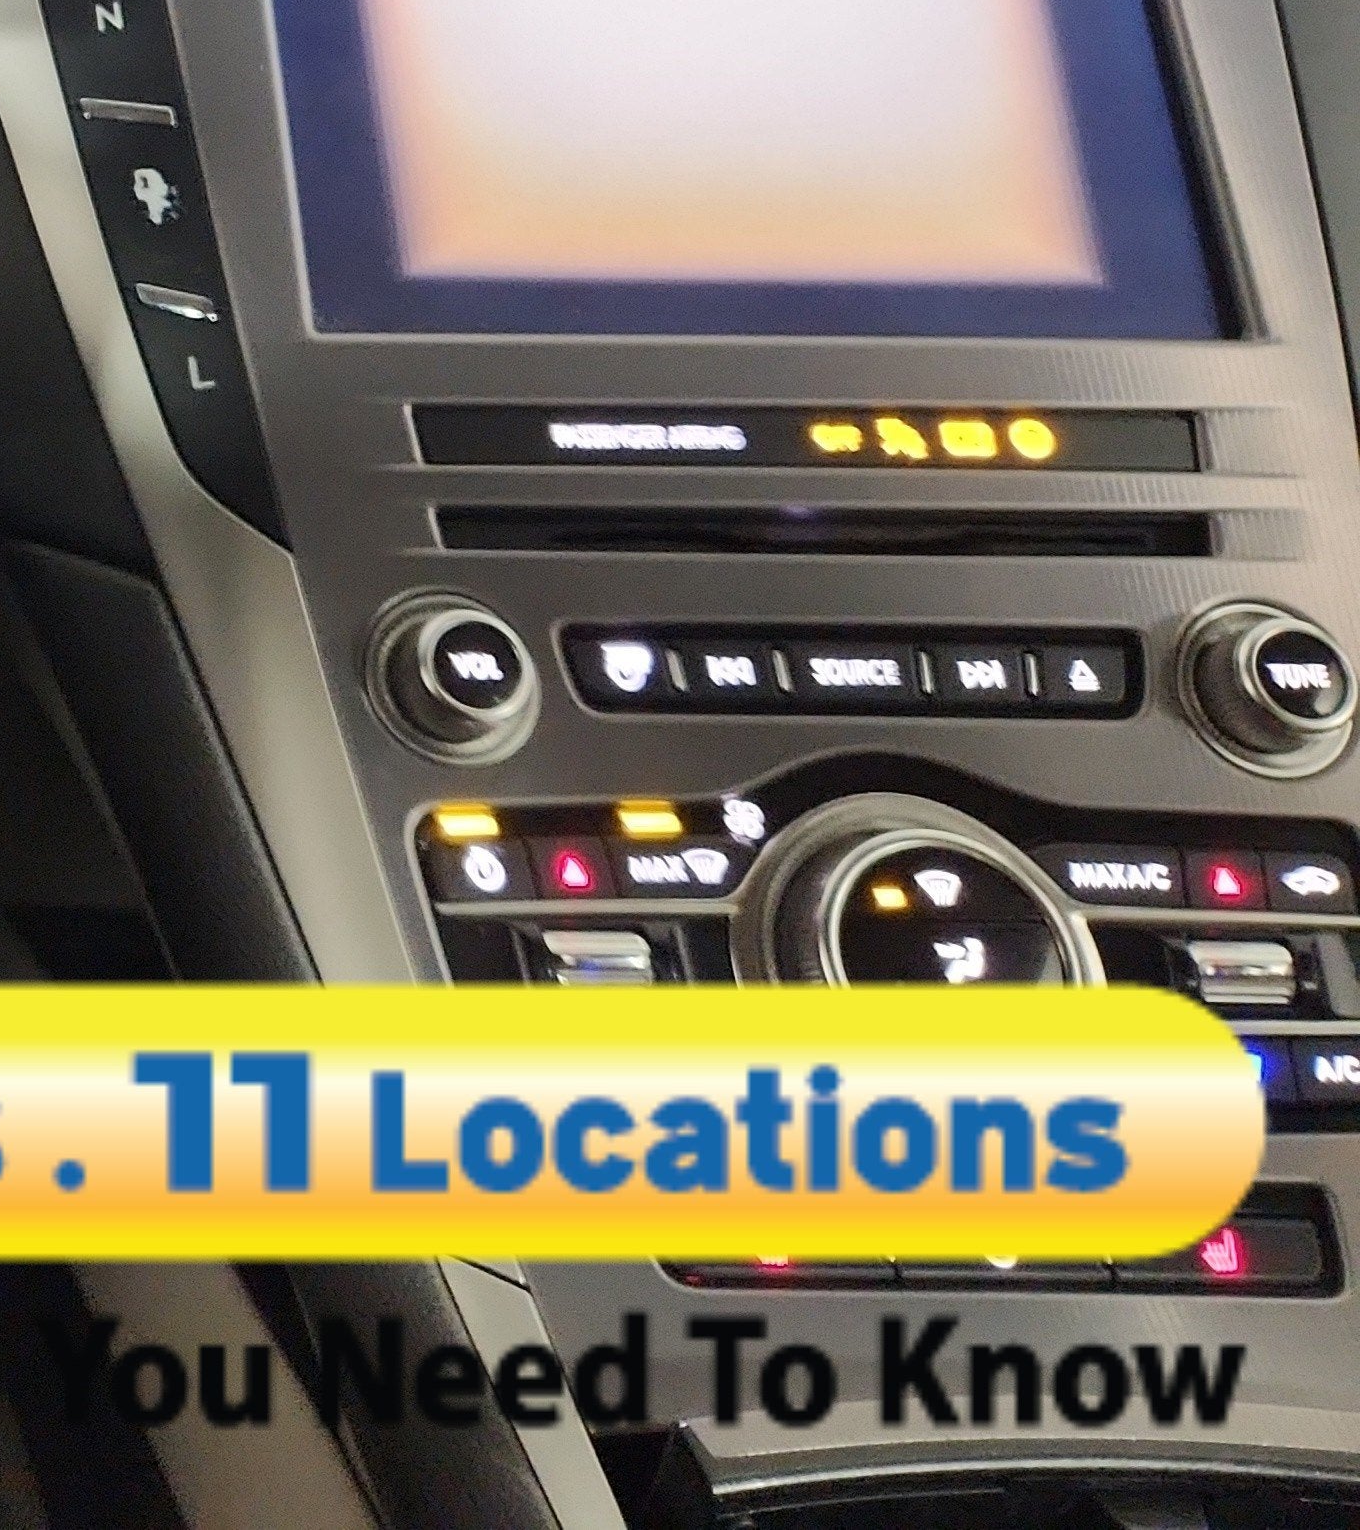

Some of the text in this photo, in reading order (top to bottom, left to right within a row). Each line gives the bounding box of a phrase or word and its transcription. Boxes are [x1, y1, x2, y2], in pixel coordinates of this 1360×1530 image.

[95, 0, 125, 33] N
[188, 356, 216, 390] L
[447, 650, 504, 682] VOL
[809, 657, 902, 687] SOURCE
[1265, 662, 1332, 690] TUNE
